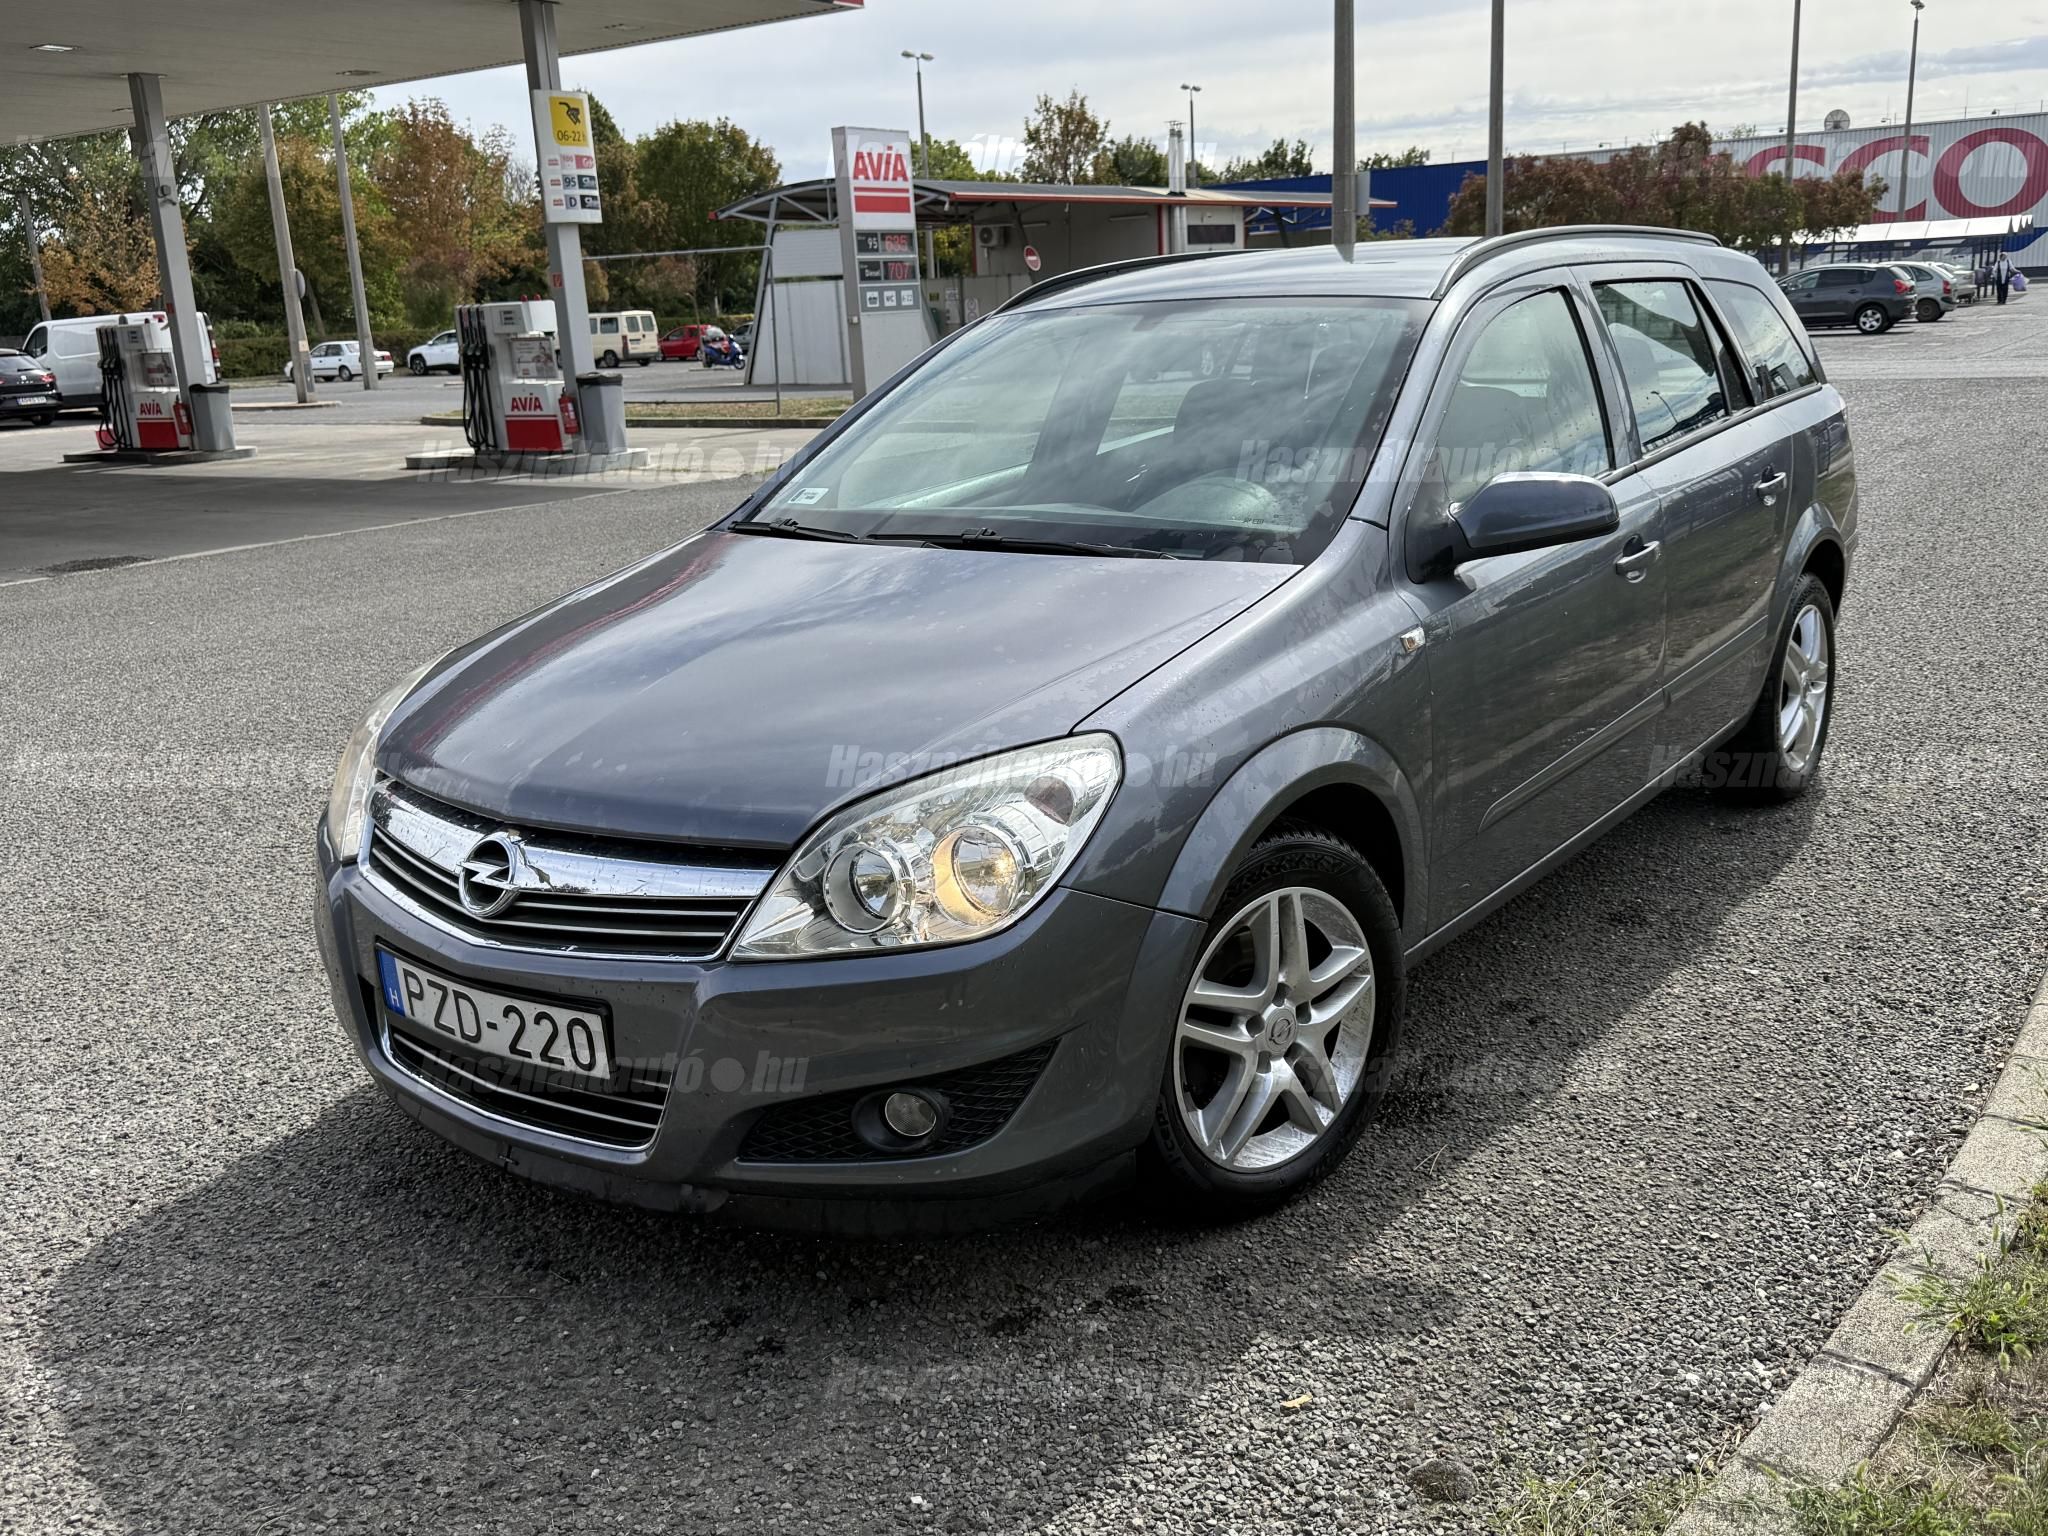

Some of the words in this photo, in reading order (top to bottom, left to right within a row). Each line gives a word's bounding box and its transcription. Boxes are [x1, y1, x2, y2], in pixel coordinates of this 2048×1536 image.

[564, 177, 577, 188] 95
[569, 197, 577, 208] D
[867, 237, 879, 250] 95
[887, 262, 911, 280] 707
[388, 987, 400, 1008] H
[402, 967, 597, 1072] PZD-220
